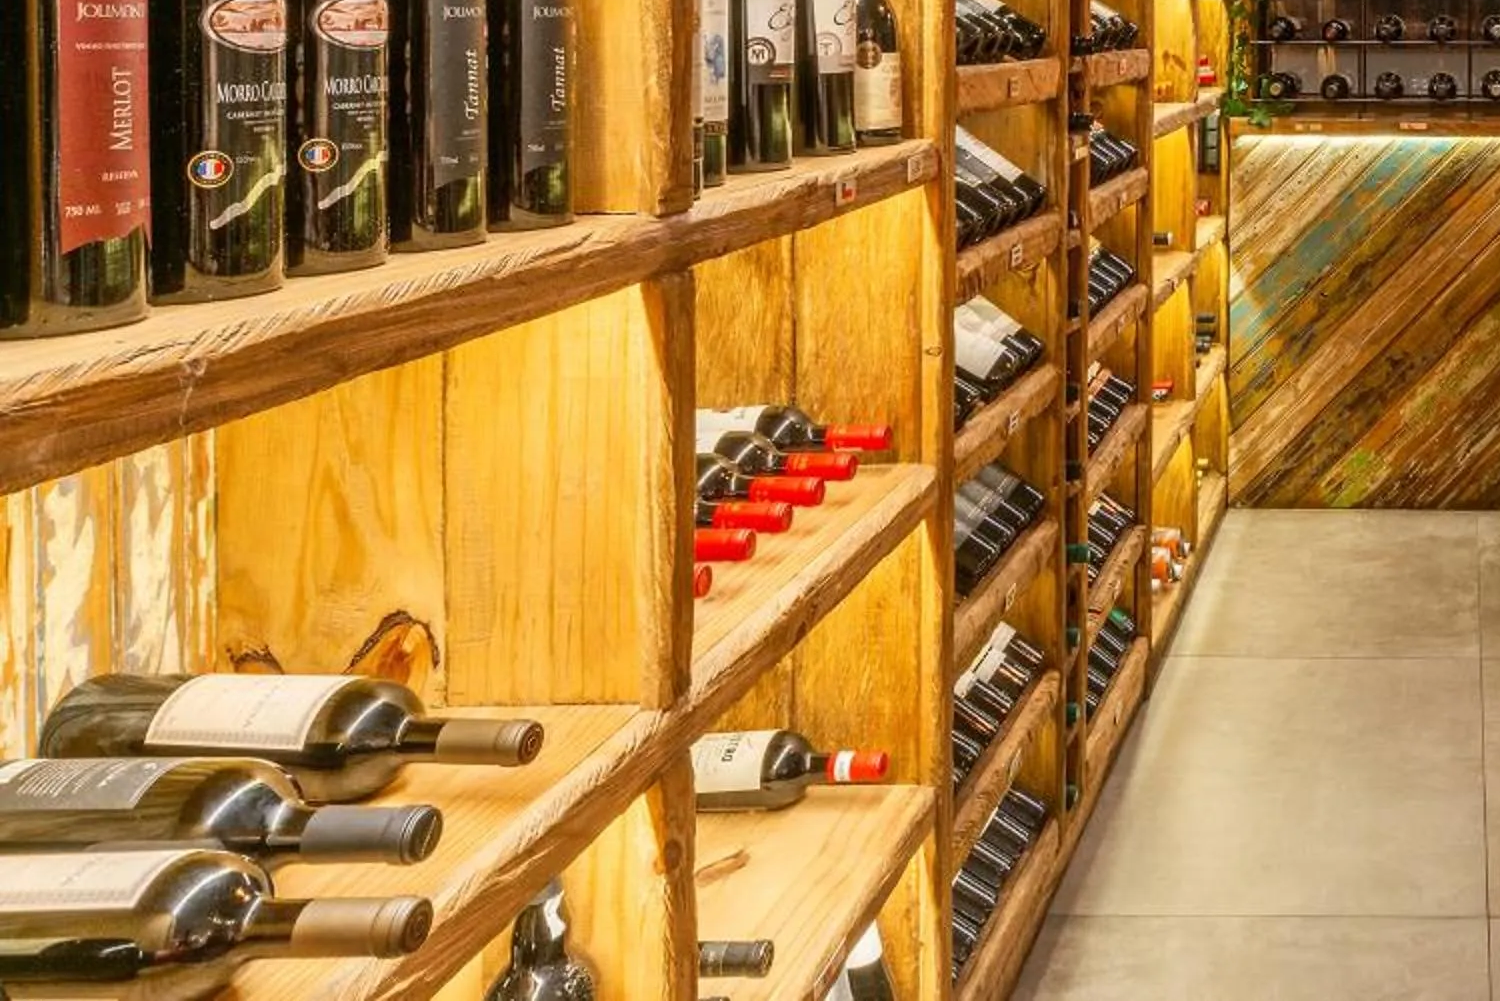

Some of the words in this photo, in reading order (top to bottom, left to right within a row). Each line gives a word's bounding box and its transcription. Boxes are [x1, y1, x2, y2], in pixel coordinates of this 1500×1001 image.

[109, 65, 133, 150] MERLOT
[463, 48, 479, 120] Tannat
[550, 46, 566, 112] Tannat
